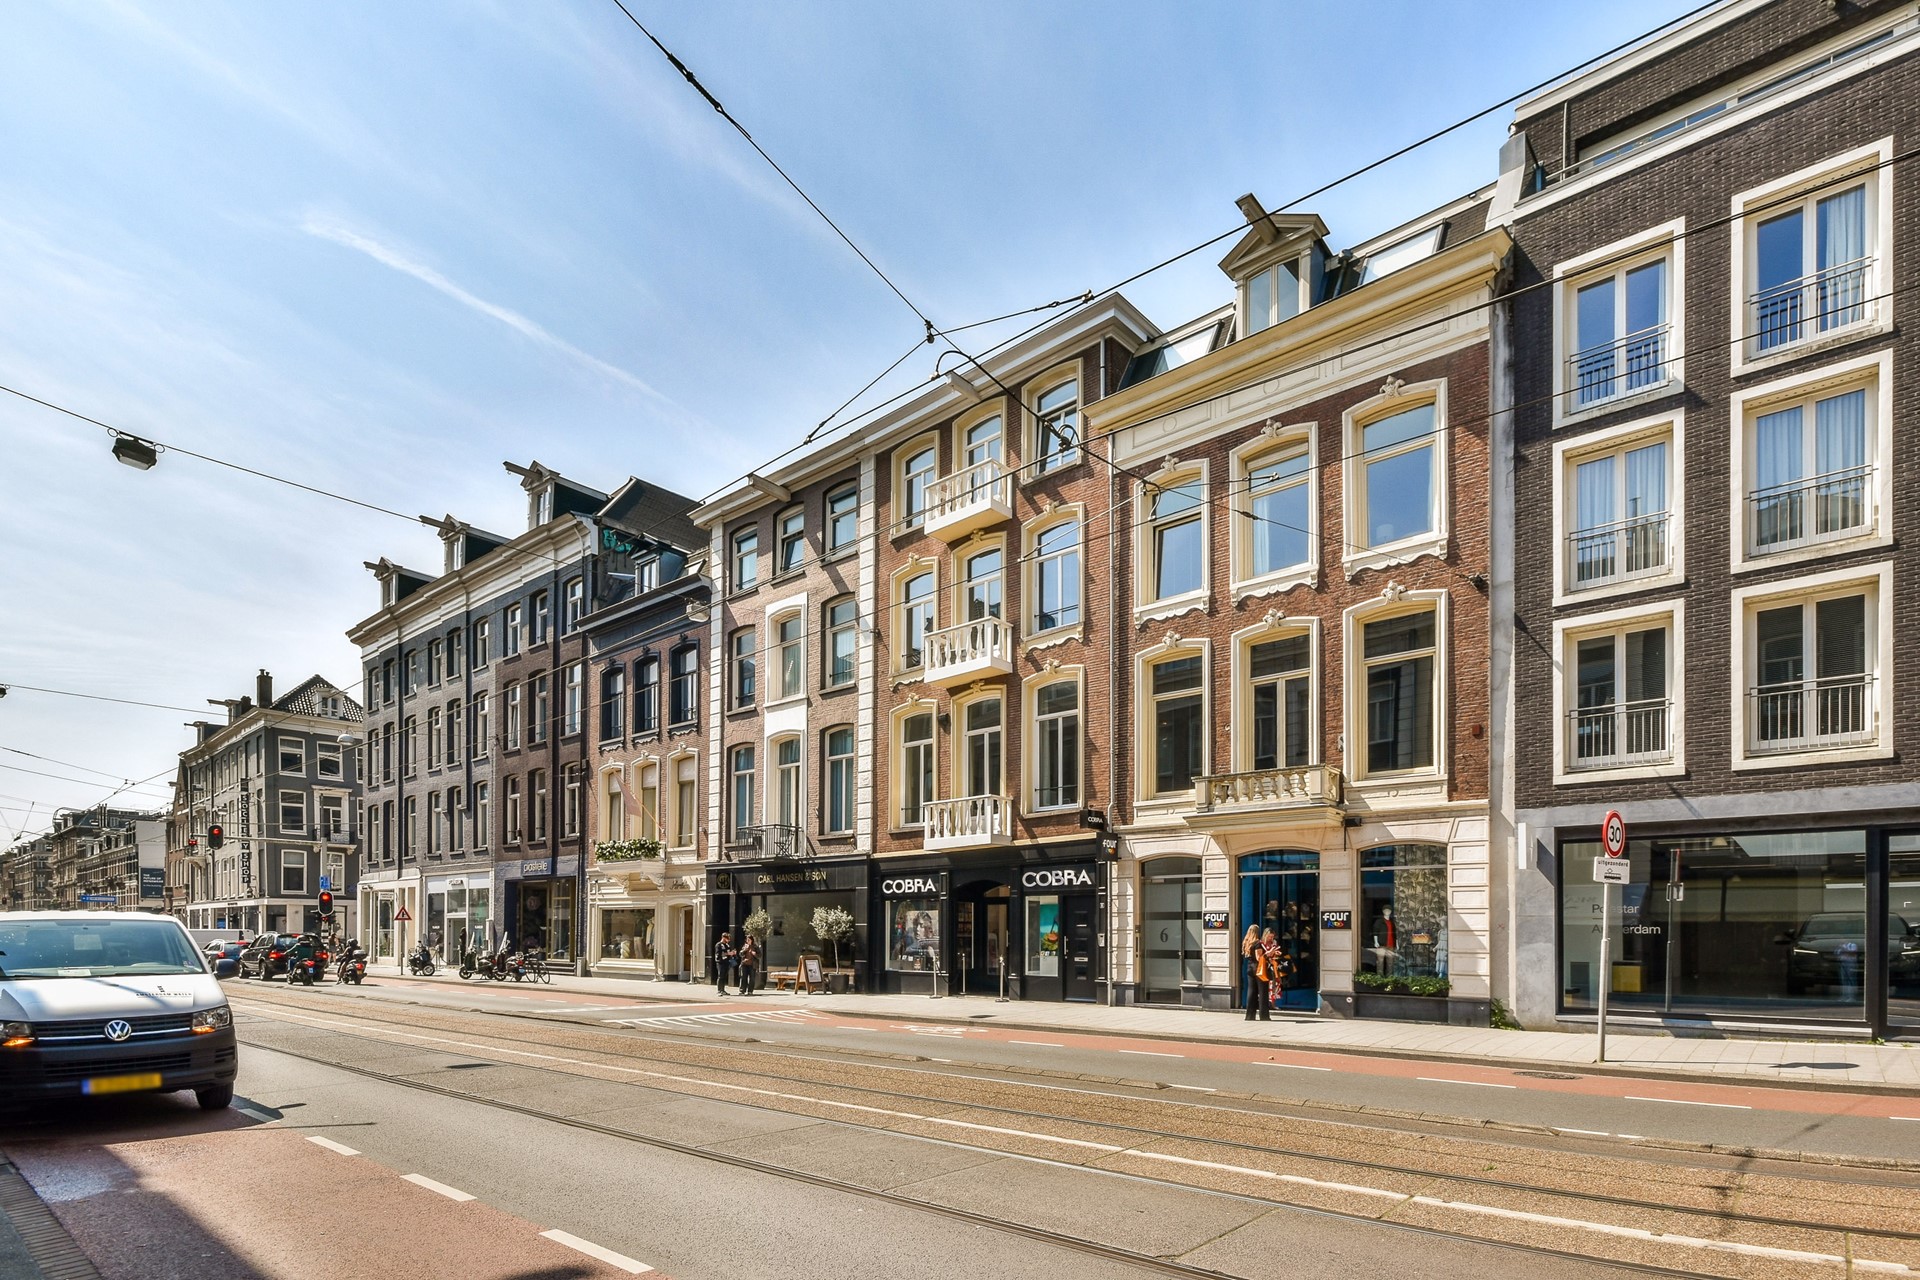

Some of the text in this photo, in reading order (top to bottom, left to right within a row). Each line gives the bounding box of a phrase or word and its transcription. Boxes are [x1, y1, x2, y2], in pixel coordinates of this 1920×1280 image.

[1609, 825, 1621, 844] 30
[242, 852, 250, 883] SHOP
[757, 875, 775, 884] CARL
[776, 873, 803, 882] HANSEN
[882, 878, 936, 894] COBRA
[1022, 869, 1092, 887] COBRA
[1322, 912, 1349, 921] four
[1592, 904, 1639, 913] Poestar
[1204, 913, 1227, 921] four
[1160, 927, 1169, 943] 6
